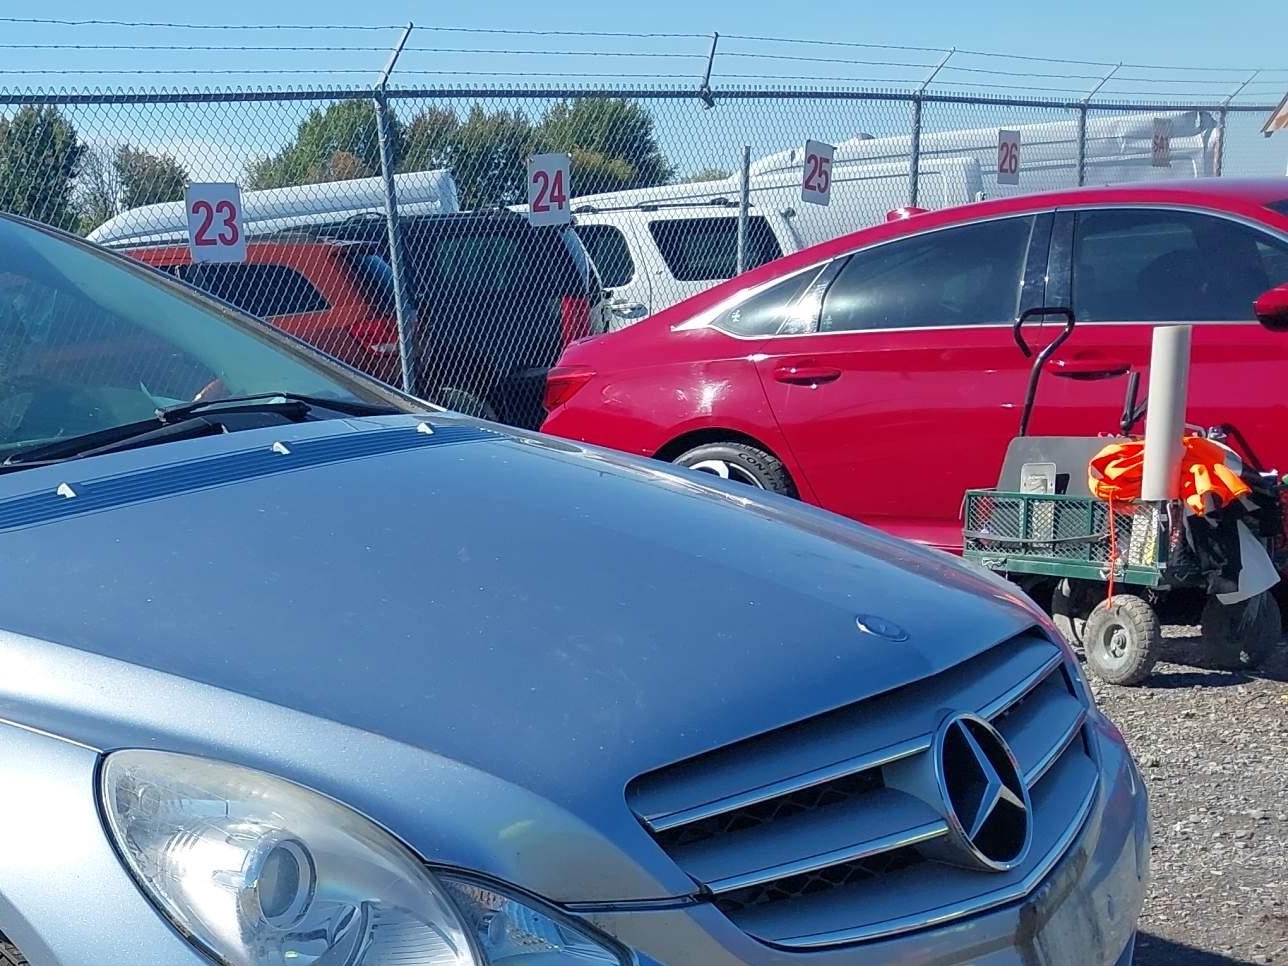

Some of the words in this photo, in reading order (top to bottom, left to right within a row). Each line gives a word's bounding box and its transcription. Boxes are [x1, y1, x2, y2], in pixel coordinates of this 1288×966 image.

[803, 154, 830, 194] 25
[1000, 141, 1018, 174] 26
[533, 170, 566, 213] 24
[191, 200, 239, 247] 23
